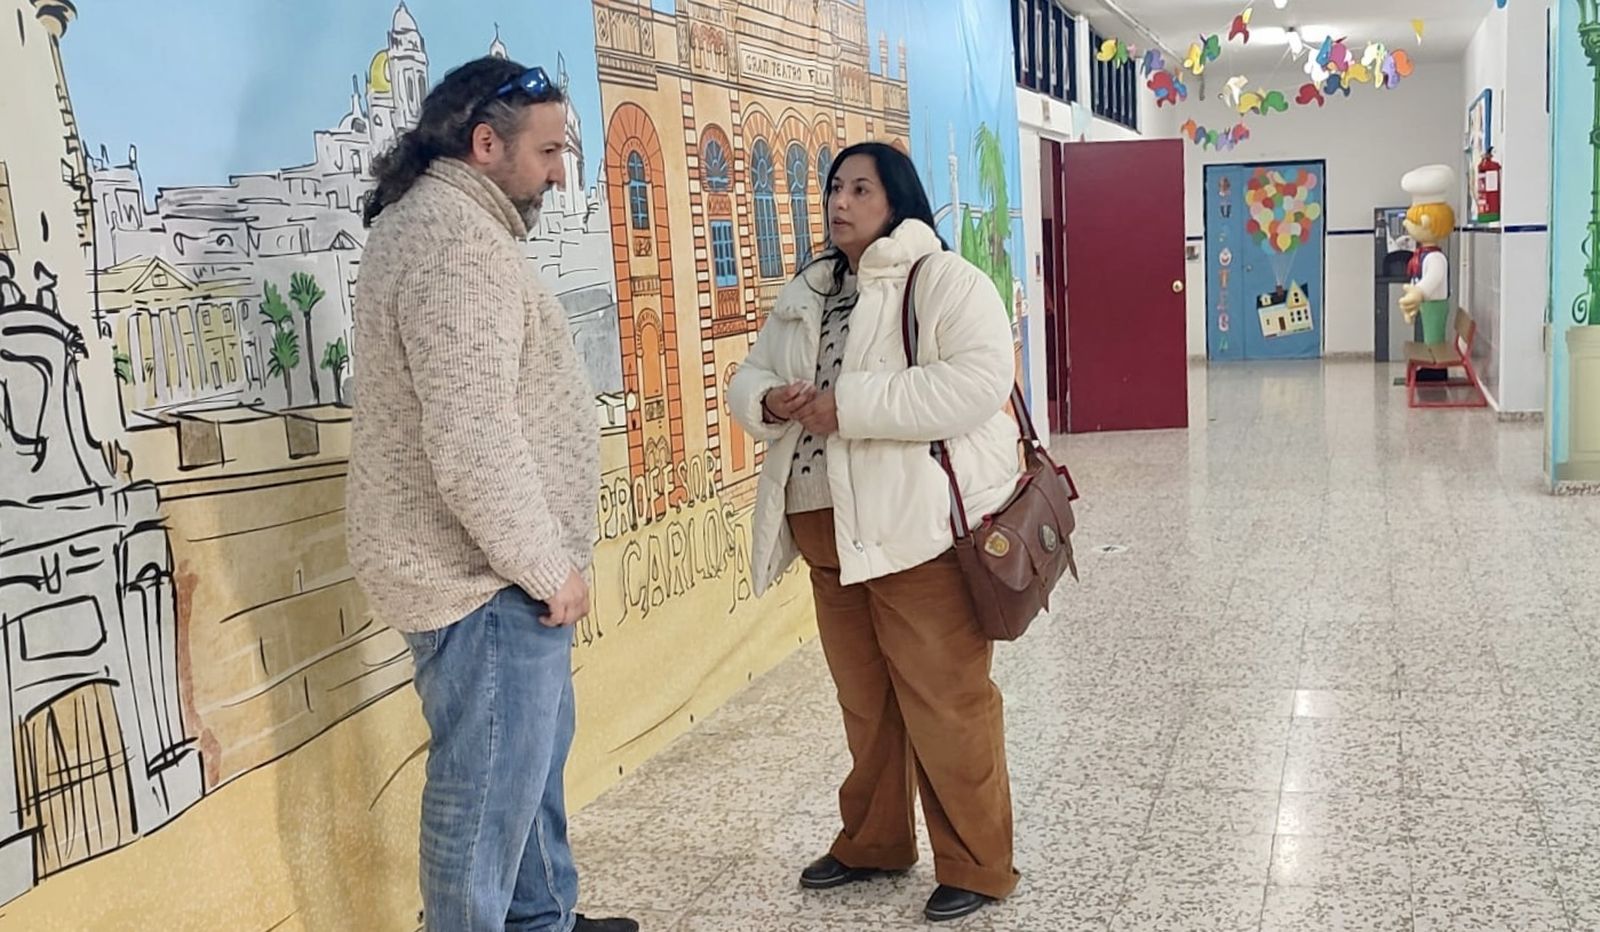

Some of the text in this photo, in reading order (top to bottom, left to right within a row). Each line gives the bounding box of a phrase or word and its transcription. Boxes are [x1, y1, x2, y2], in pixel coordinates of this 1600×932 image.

[772, 61, 802, 81] TEATRO
[595, 449, 718, 545] PROFESOR
[618, 503, 736, 625] CARLOS
